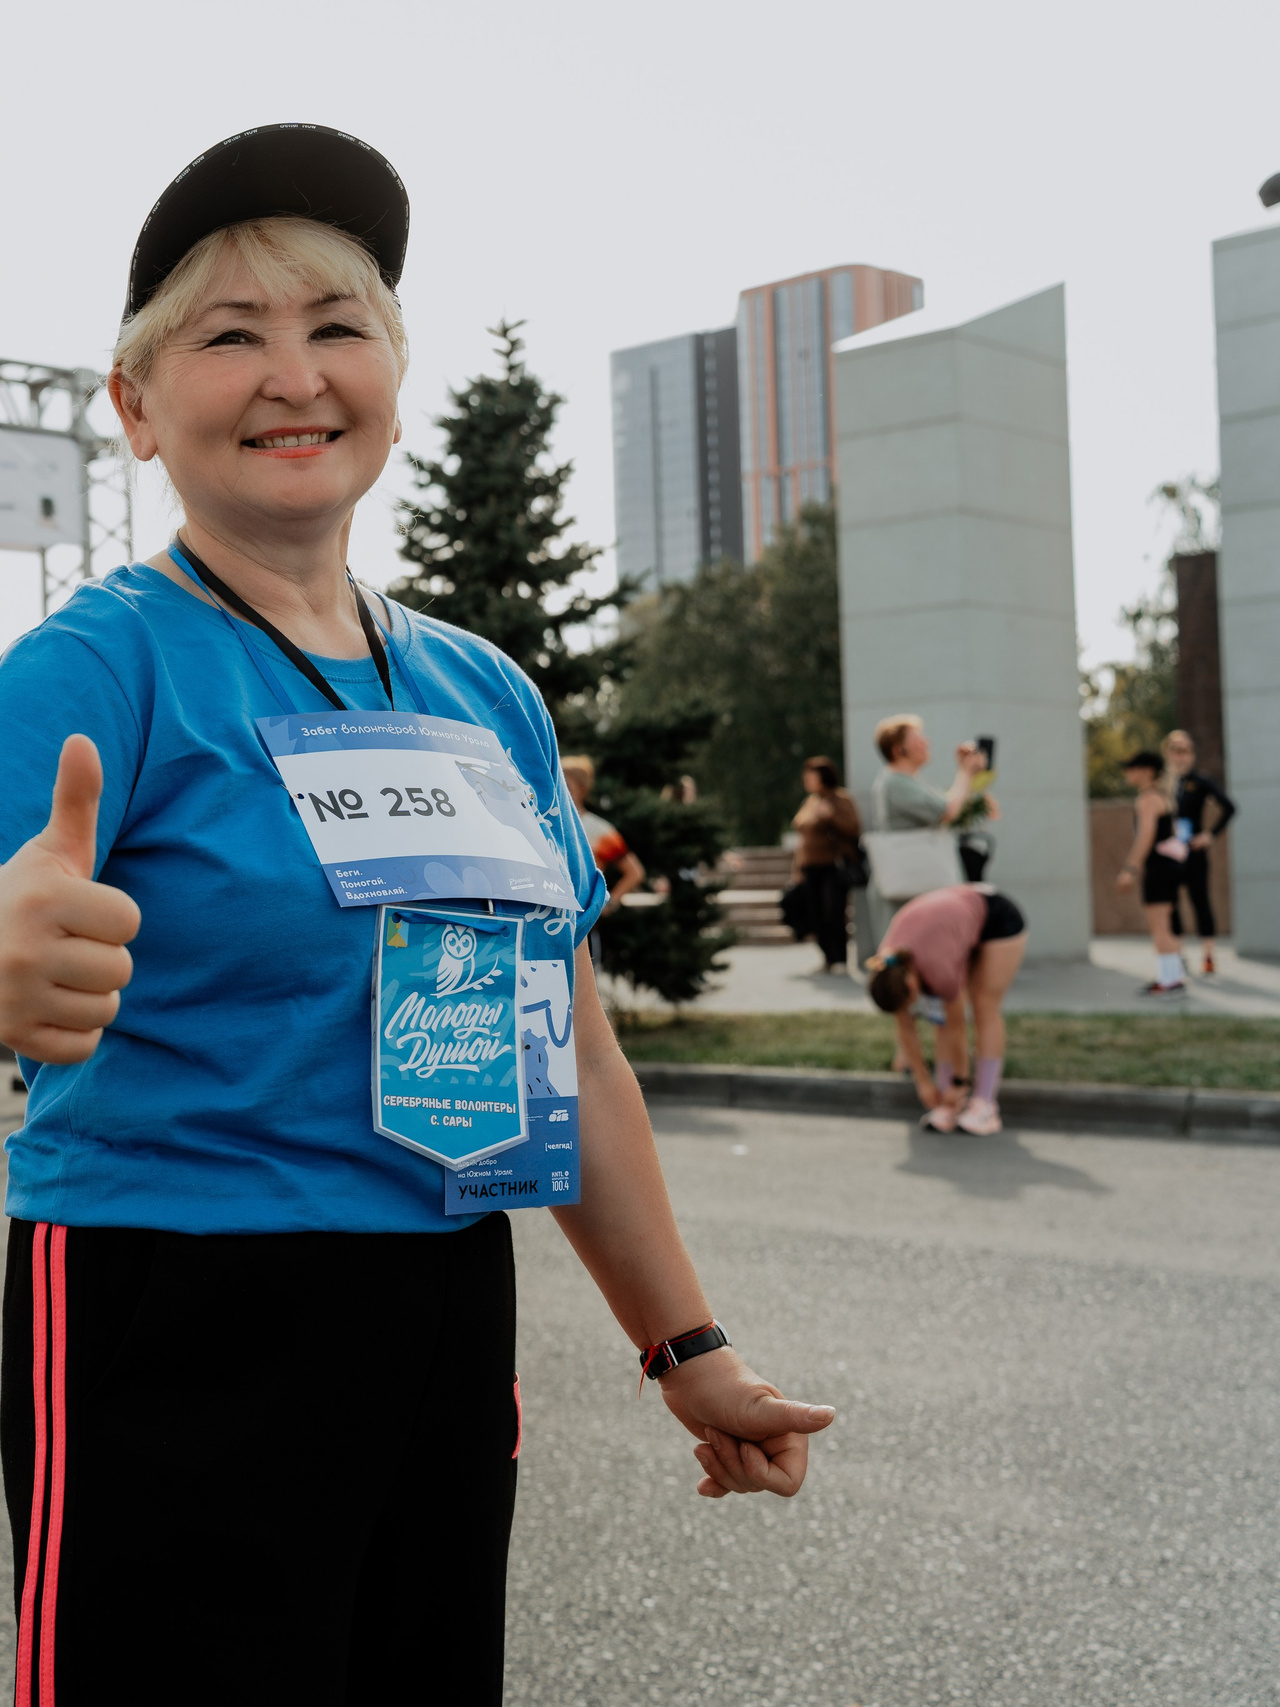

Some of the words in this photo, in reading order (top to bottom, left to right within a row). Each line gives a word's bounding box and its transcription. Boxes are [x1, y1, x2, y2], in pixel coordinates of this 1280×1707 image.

[300, 725, 338, 737] Забег
[340, 722, 418, 736] волонтёров
[418, 727, 461, 742] Южного
[462, 734, 490, 748] Урала
[307, 788, 370, 823] №
[379, 787, 457, 818] 258
[335, 868, 364, 879] Беги.
[340, 876, 387, 889] Помогай.
[345, 886, 408, 900] Вдохновляй.
[384, 991, 504, 1040] Молоды
[396, 1031, 512, 1079] Душой
[383, 1095, 452, 1110] СЕРЕБРЯНЫЕ
[454, 1099, 517, 1114] ВОЛОНТЕРЫ
[430, 1114, 440, 1126] С.
[442, 1115, 473, 1128] САРЫ
[478, 1158, 498, 1166] добро
[466, 1170, 492, 1178] Южном
[493, 1168, 514, 1177] Урале
[458, 1179, 539, 1200] УЧАСТНИК
[551, 1179, 570, 1192] 100.4
